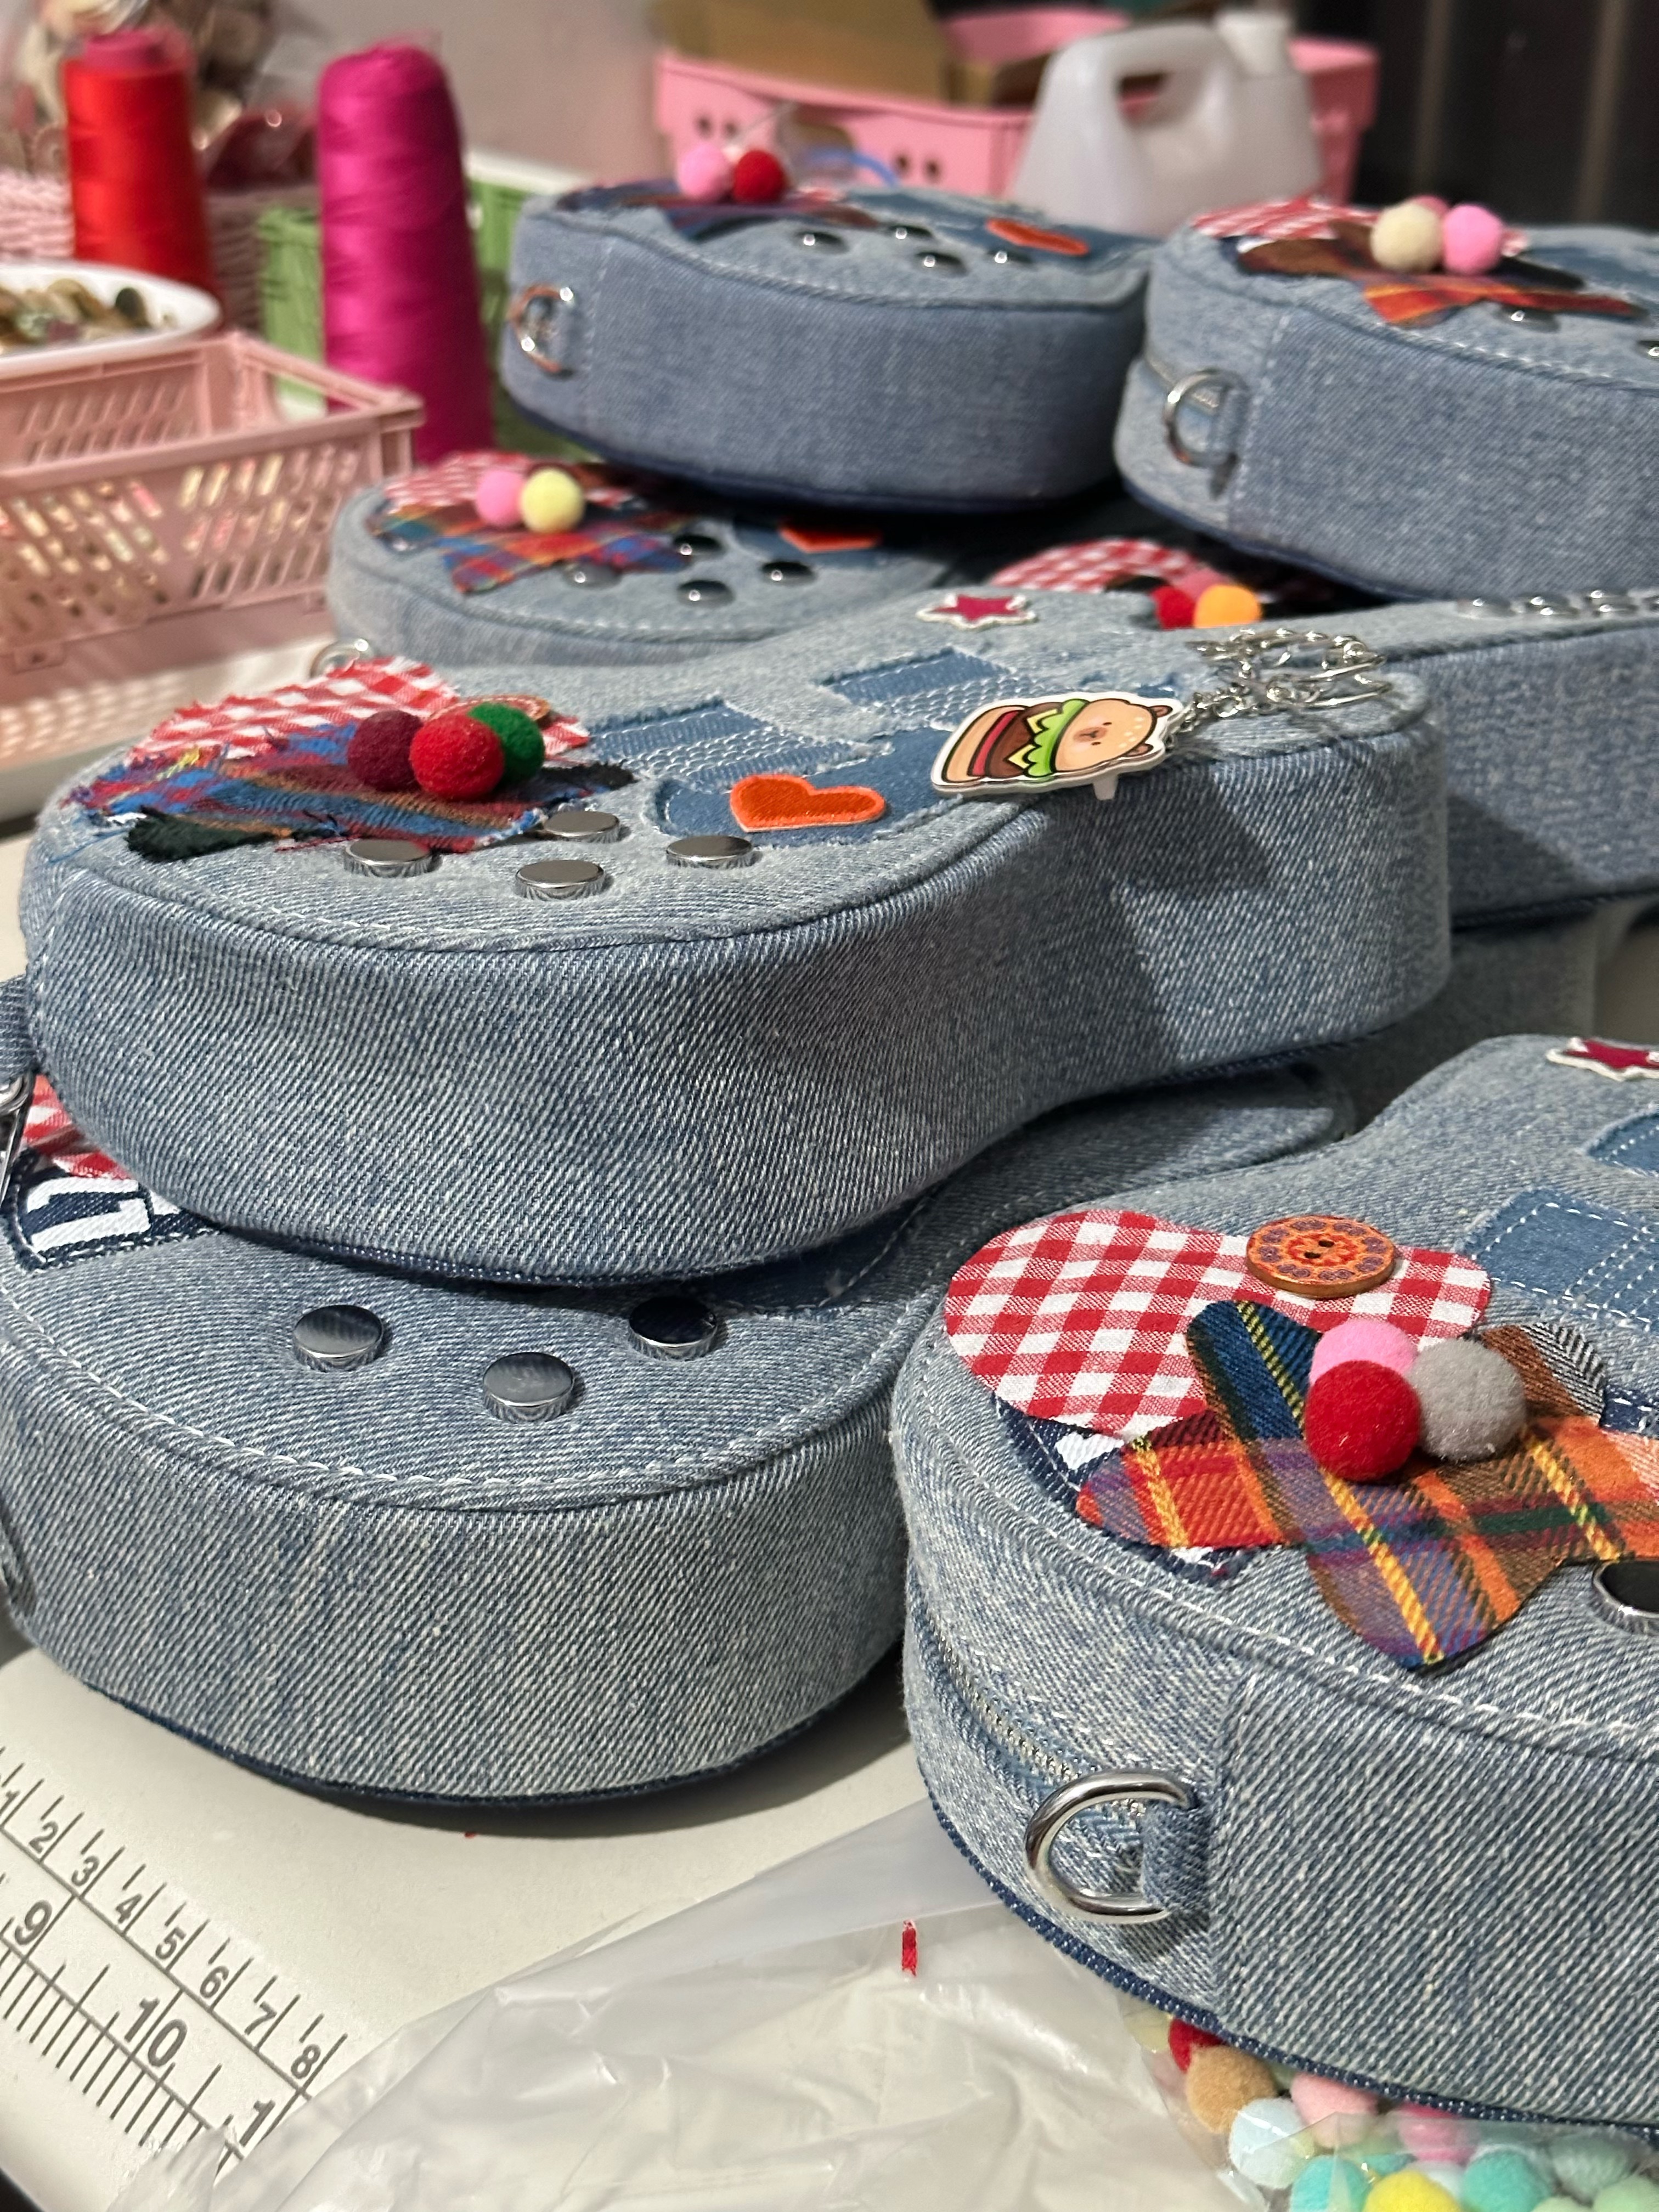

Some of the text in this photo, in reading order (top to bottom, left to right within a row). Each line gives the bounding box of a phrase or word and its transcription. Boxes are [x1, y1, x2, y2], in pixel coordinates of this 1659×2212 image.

[0, 1791, 321, 2080] 1 2 3 4 5 6 7 8
[14, 1900, 276, 2147] 9 10 1
